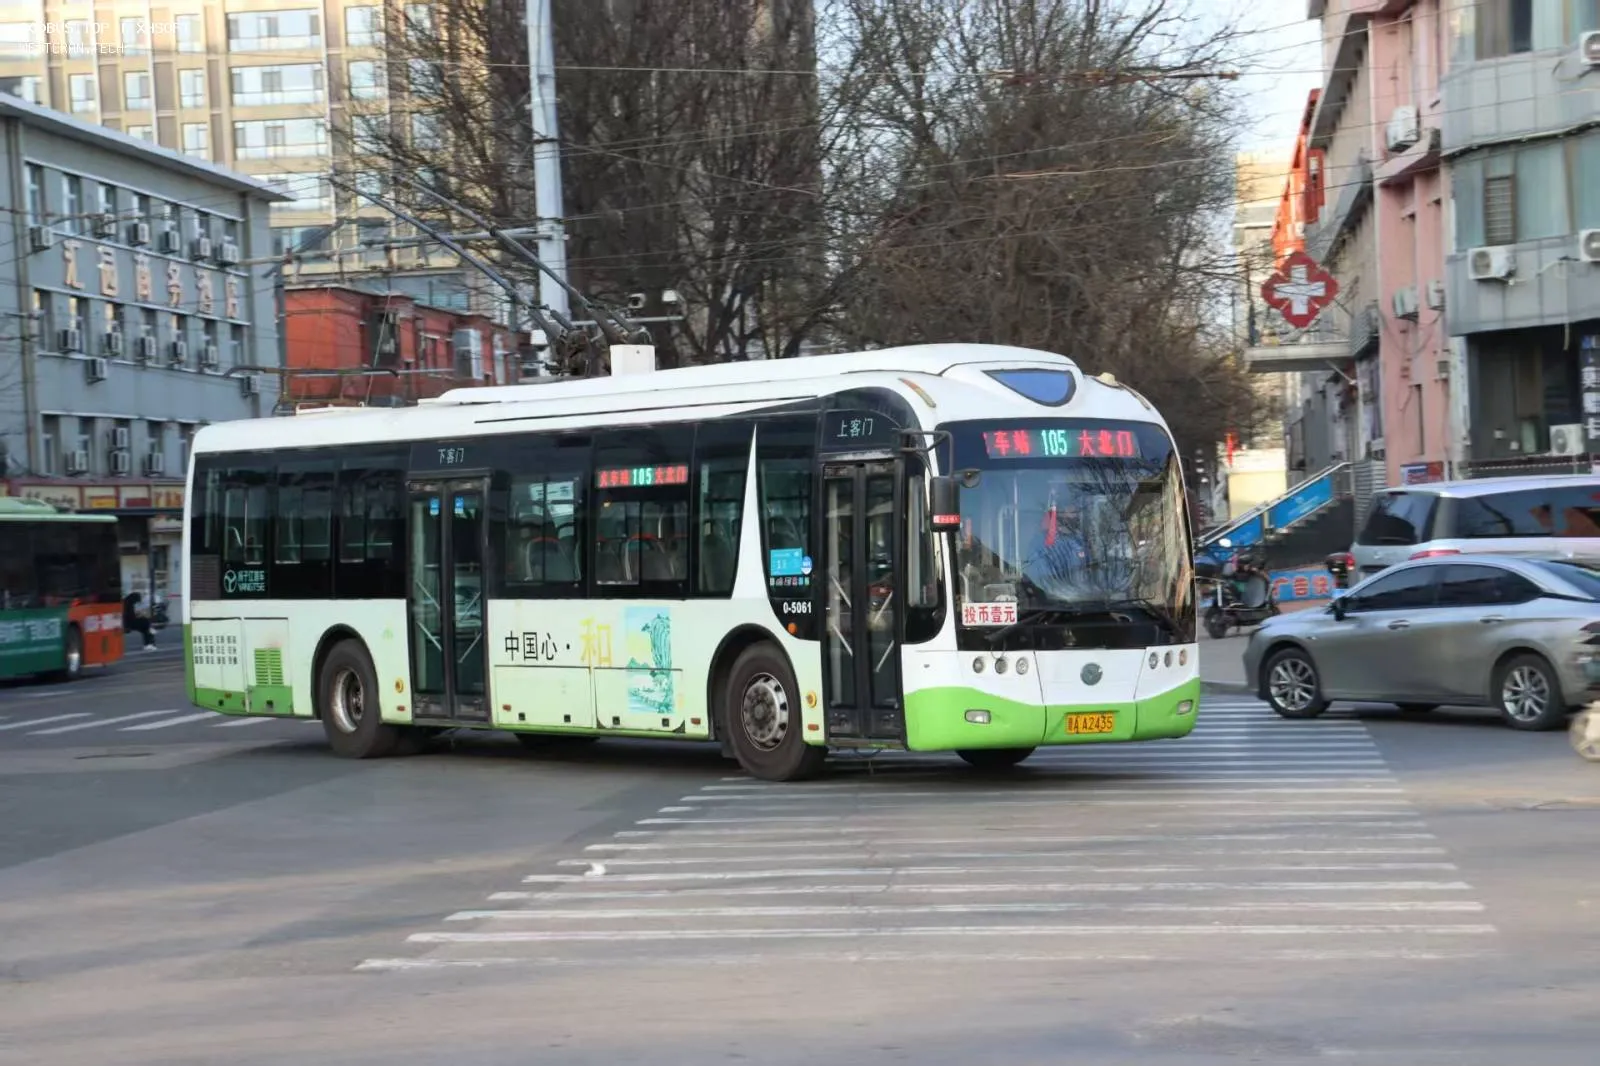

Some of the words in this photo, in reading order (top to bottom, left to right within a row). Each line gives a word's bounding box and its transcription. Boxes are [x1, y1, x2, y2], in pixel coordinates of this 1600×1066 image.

[837, 418, 873, 437] 上客门
[983, 430, 1030, 456] 车站
[1041, 430, 1068, 456] 105
[438, 448, 464, 464] 下客门
[633, 467, 652, 485] 105
[783, 601, 812, 614] 0-5061
[965, 605, 1016, 624] 投币壹元
